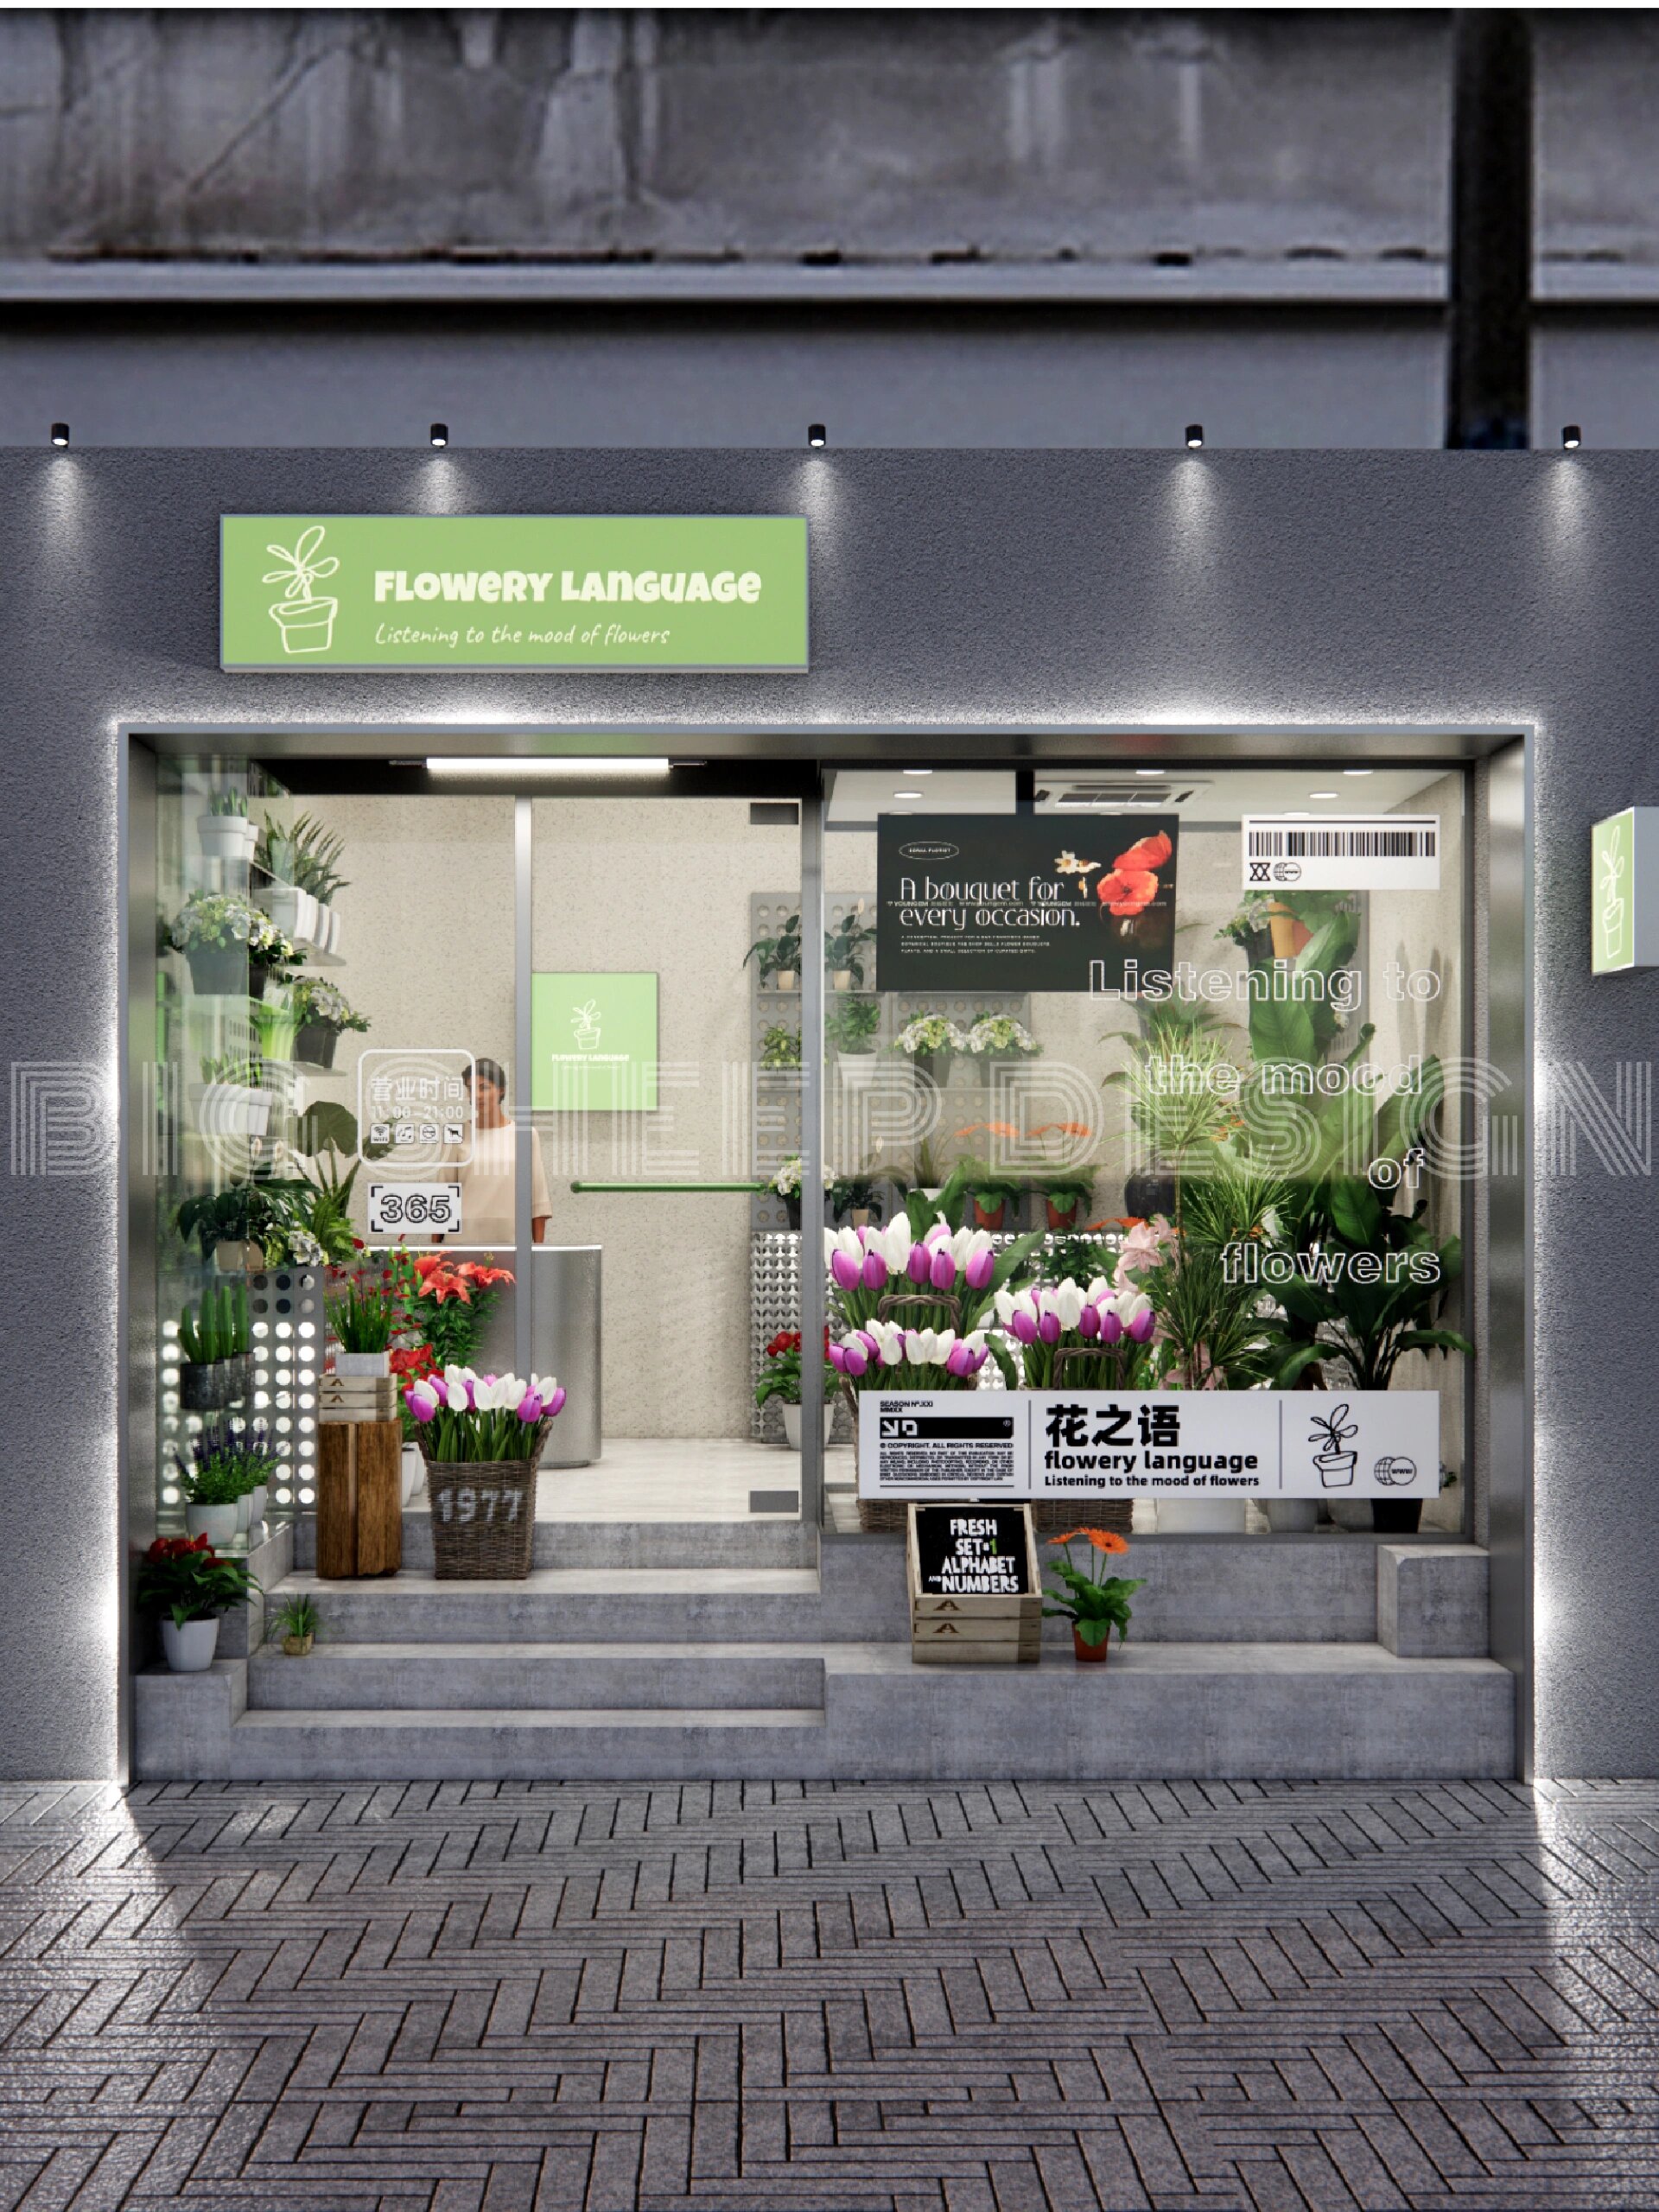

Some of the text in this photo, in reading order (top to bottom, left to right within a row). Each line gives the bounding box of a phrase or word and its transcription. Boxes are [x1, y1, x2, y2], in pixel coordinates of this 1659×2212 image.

[375, 622, 671, 648] Listening to the mood of flowers
[900, 875, 1065, 906] A bouquet for
[899, 907, 1081, 931] every occasion.
[1089, 959, 1441, 1012] Listening to
[1145, 1053, 1422, 1096] the mood
[372, 1076, 464, 1102] 营业时间
[1368, 1147, 1425, 1190] of
[380, 1193, 451, 1224] 365
[1220, 1242, 1441, 1285] flowers
[1046, 1404, 1181, 1448] 花之语
[1044, 1450, 1259, 1474] flowery language
[1044, 1474, 1260, 1489] Listening to the mood of flowers
[437, 1485, 524, 1522] 1977
[950, 1518, 998, 1536] FRESH
[941, 1555, 1016, 1574] ALPHABET
[942, 1574, 1020, 1593] NUMBERS
